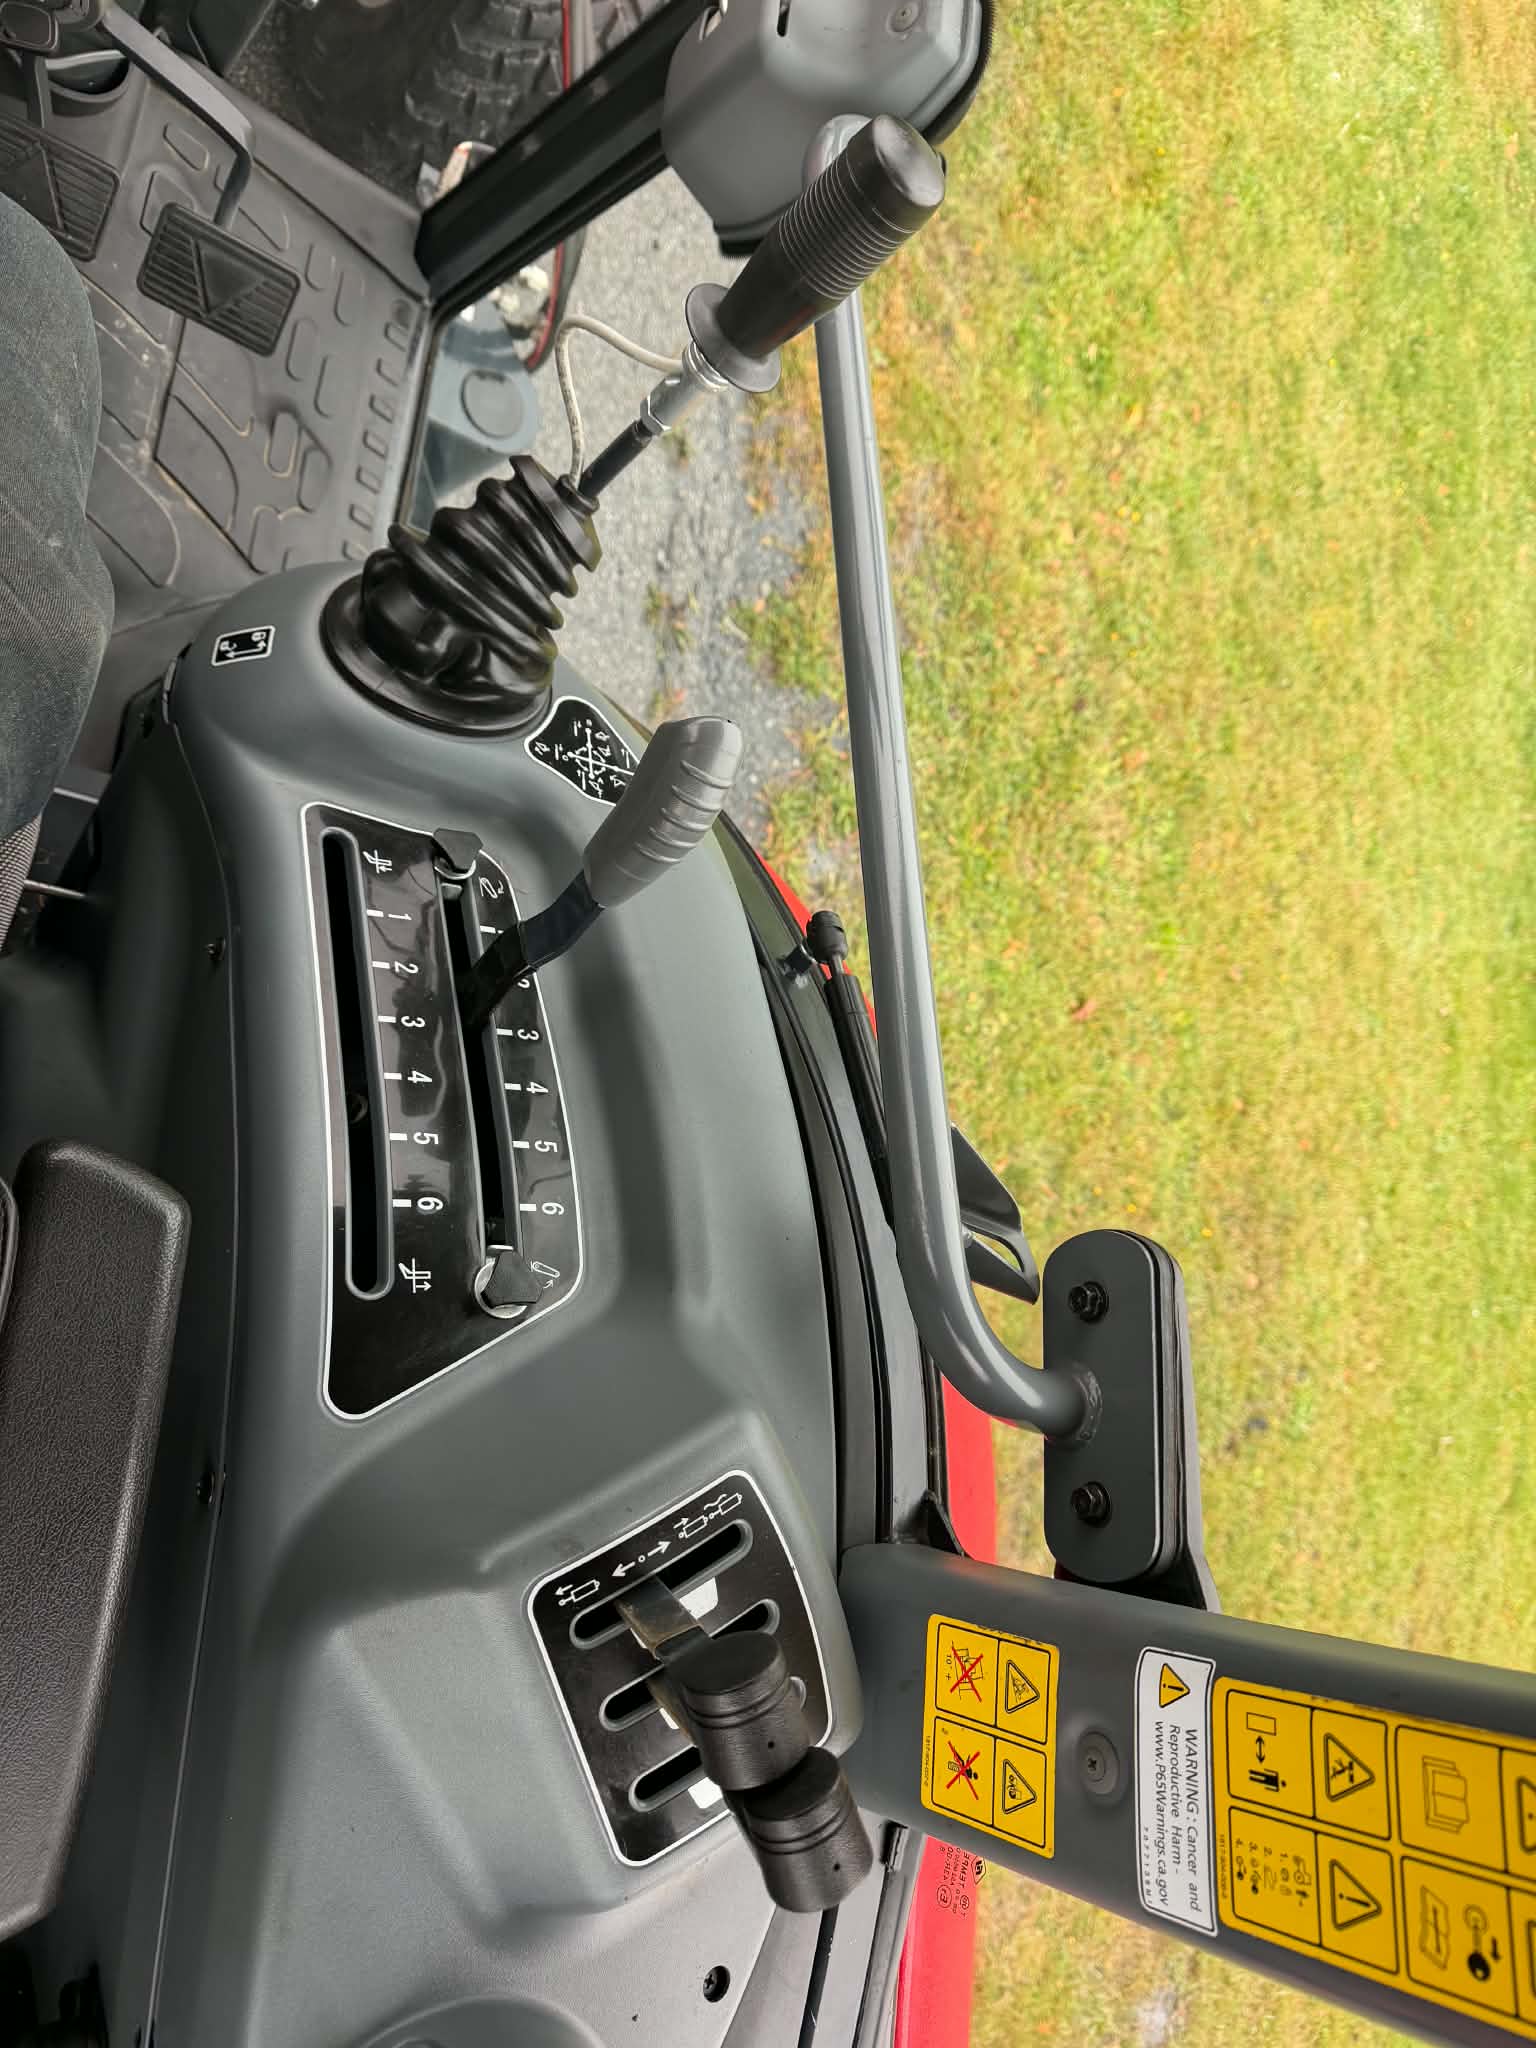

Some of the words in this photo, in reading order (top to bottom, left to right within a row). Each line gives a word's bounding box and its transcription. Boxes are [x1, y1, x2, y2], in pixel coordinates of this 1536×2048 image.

[388, 913, 412, 921] 1
[394, 960, 419, 975] 2
[400, 1015, 426, 1028] 3
[517, 1028, 540, 1041] 3
[407, 1070, 433, 1084] 4
[526, 1081, 549, 1094] 4
[412, 1131, 439, 1145] 5
[534, 1140, 558, 1153] 5
[417, 1196, 444, 1211] 6
[541, 1202, 565, 1216] 6
[1168, 1724, 1182, 1818] Reproductive
[1154, 1720, 1169, 1906] www.P65Warnings.ca.gov
[1171, 1825, 1184, 1865] Harm
[1186, 1825, 1200, 1875] Cancer
[1188, 1882, 1202, 1912] and
